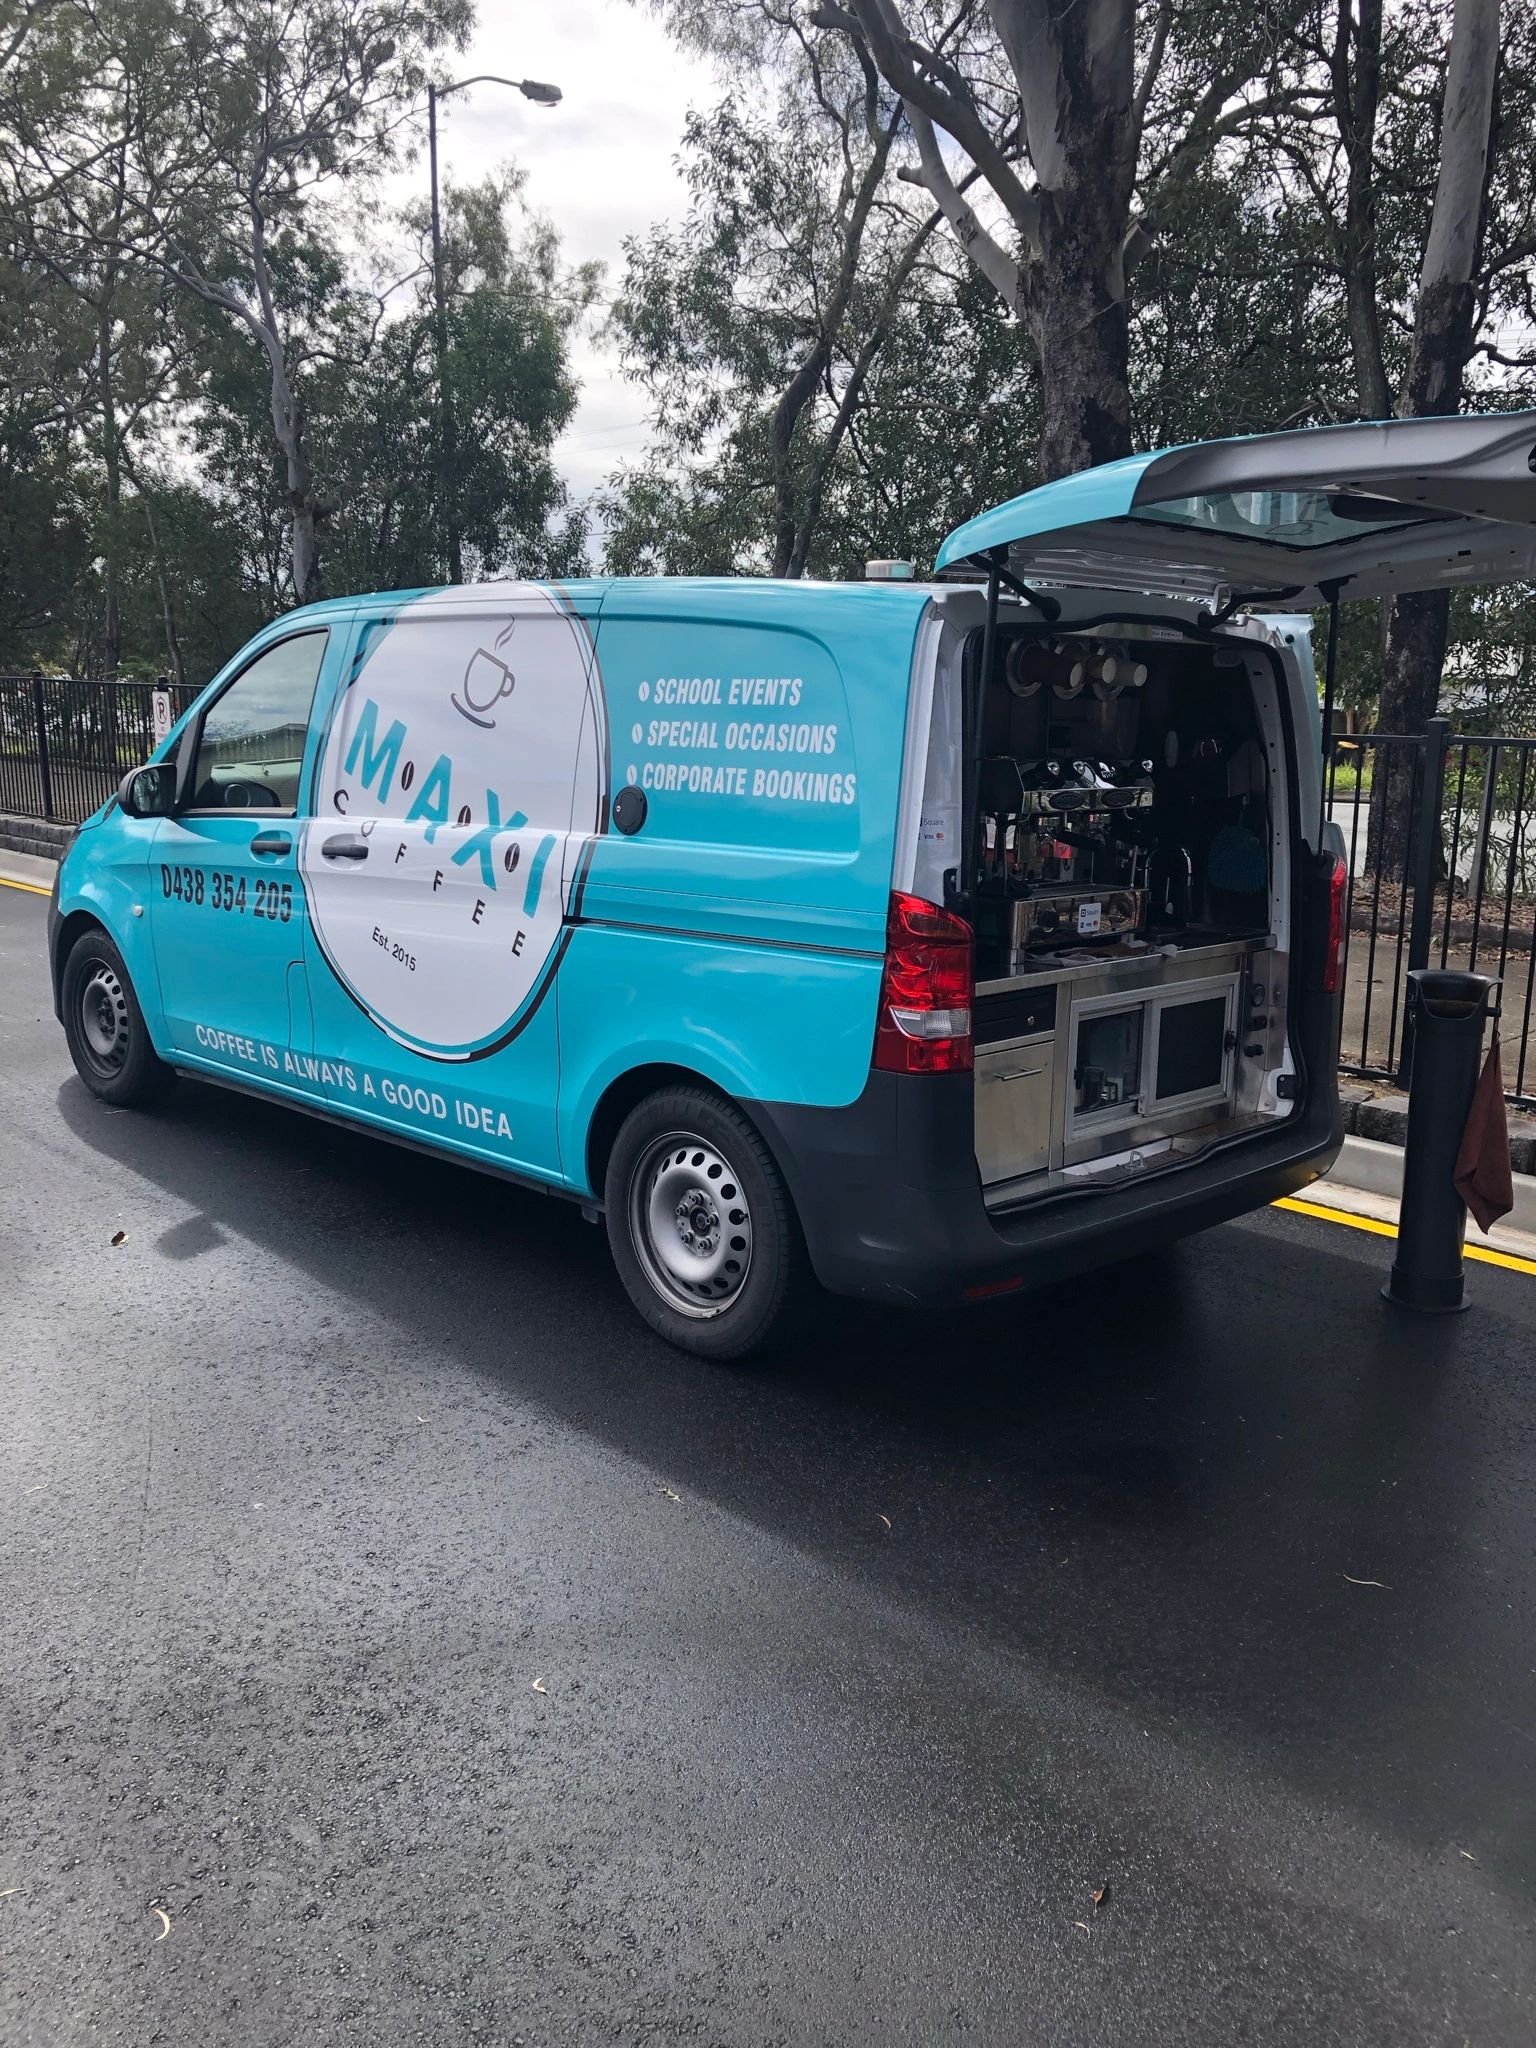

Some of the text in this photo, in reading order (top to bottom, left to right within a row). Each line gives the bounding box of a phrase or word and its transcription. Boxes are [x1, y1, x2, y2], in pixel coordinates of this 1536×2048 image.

[654, 678, 803, 706] SCHOOL EVENTS
[647, 720, 838, 754] SPECIAL OCCASIONS
[642, 763, 857, 805] CORPORATE BOOKINGS
[344, 698, 557, 918] MAXI
[161, 863, 292, 922] 0438 354 205
[372, 926, 416, 971] Est. 2015
[195, 1024, 513, 1141] COFFEE IS ALWAYS A GOOD IDEA
